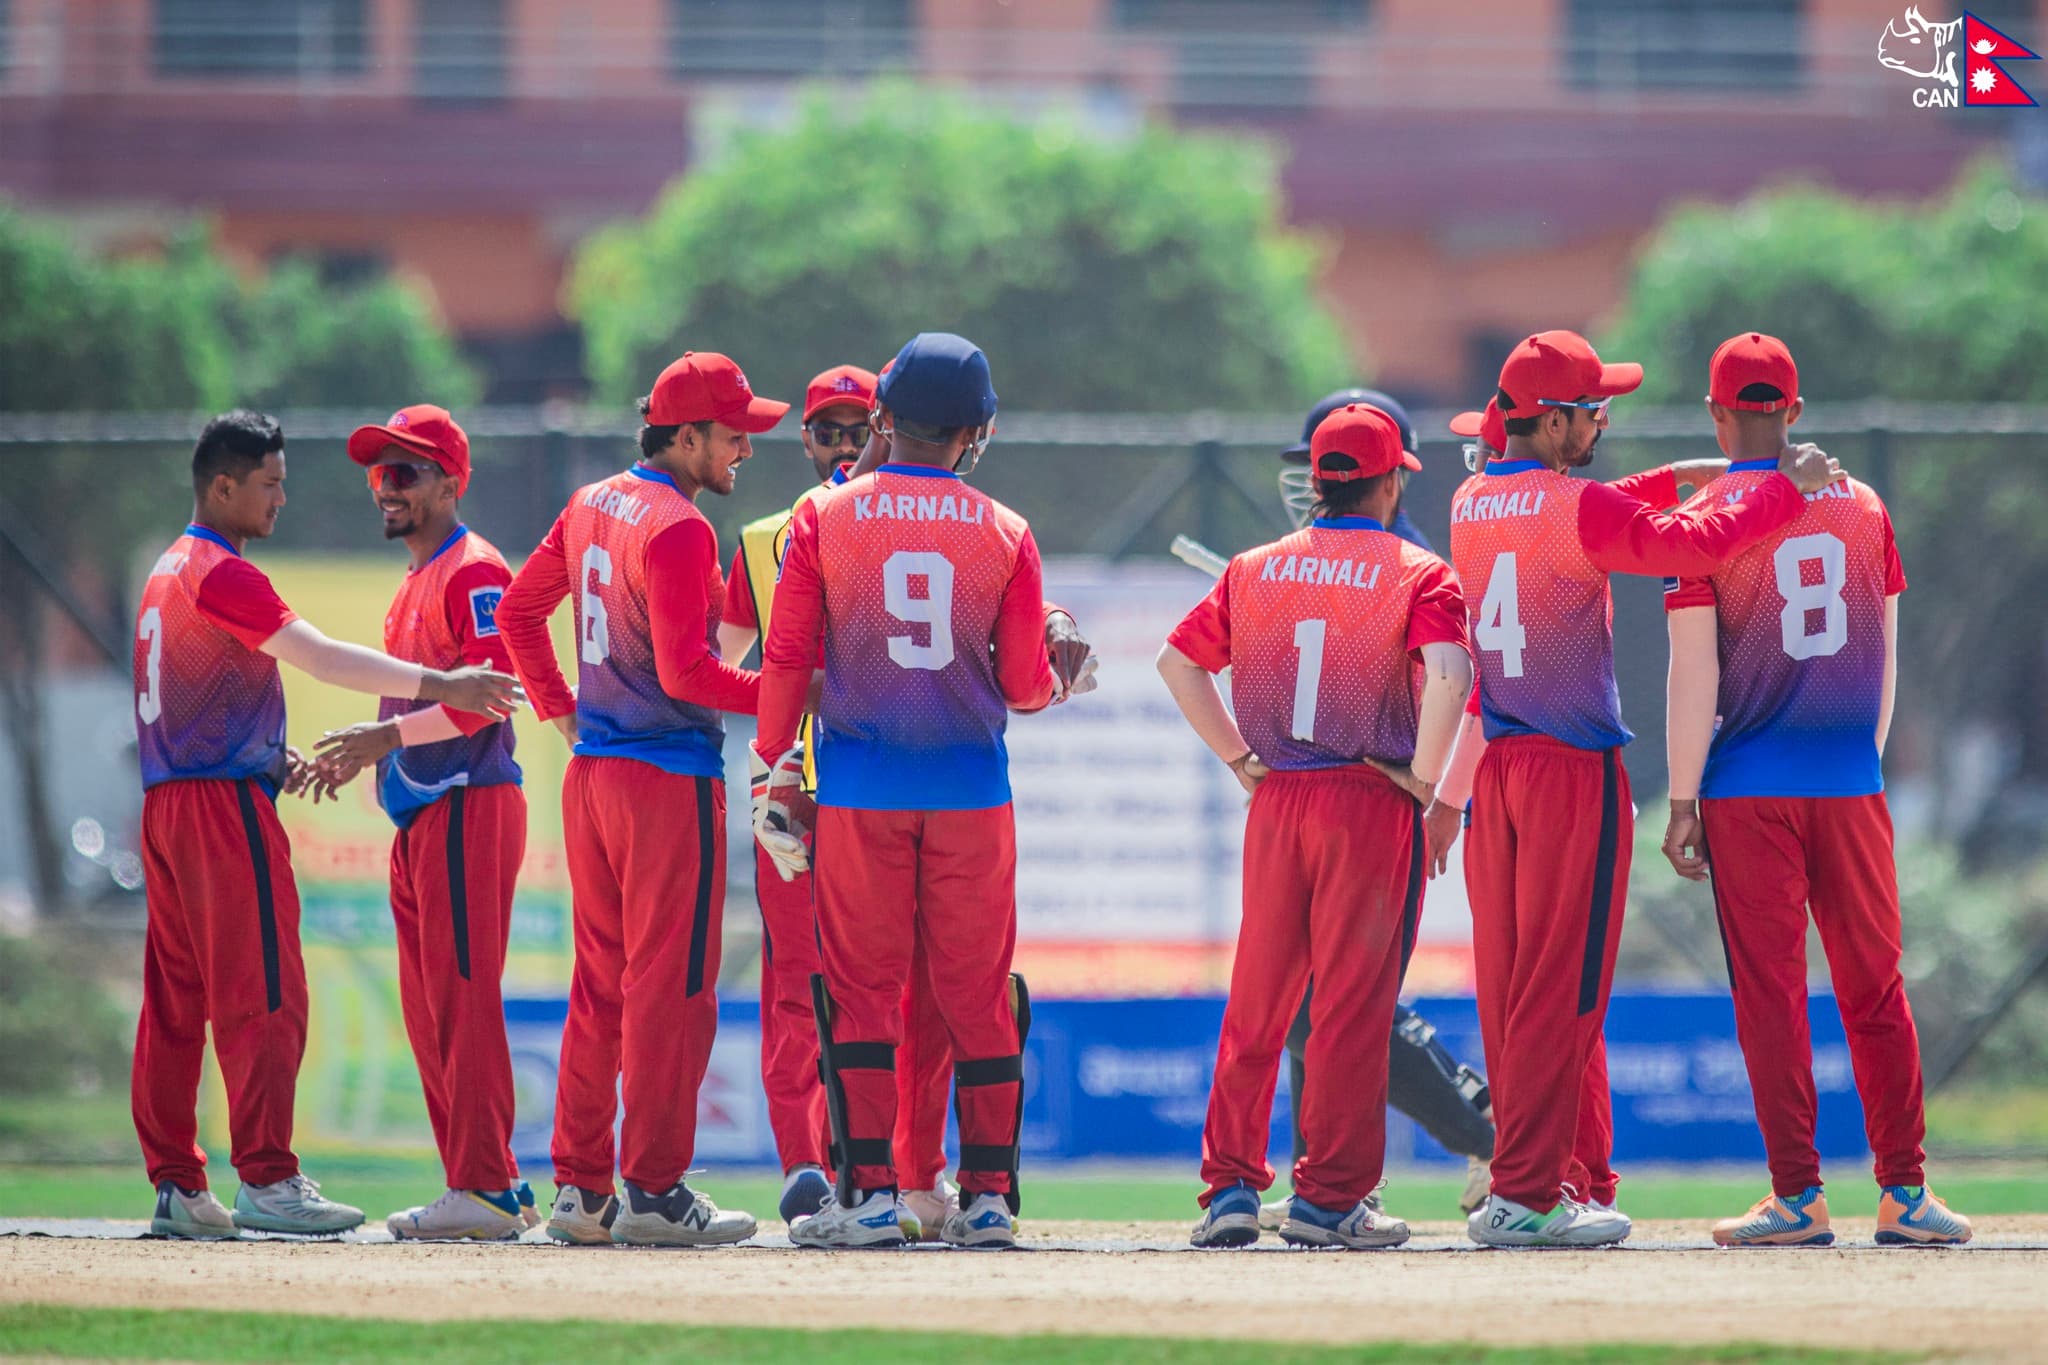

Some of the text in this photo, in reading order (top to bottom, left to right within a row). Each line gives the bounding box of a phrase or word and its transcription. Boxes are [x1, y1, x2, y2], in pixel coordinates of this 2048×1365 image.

[584, 485, 651, 527] KARNALI
[854, 493, 985, 526] KARNALI
[1451, 490, 1546, 524] KARNALI
[581, 543, 613, 666] 6
[882, 550, 956, 672] 9
[1260, 554, 1383, 590] KARNALI
[1475, 551, 1527, 679] 4
[1773, 532, 1848, 661] 8
[138, 606, 162, 726] 3
[1291, 618, 1327, 743] 1
